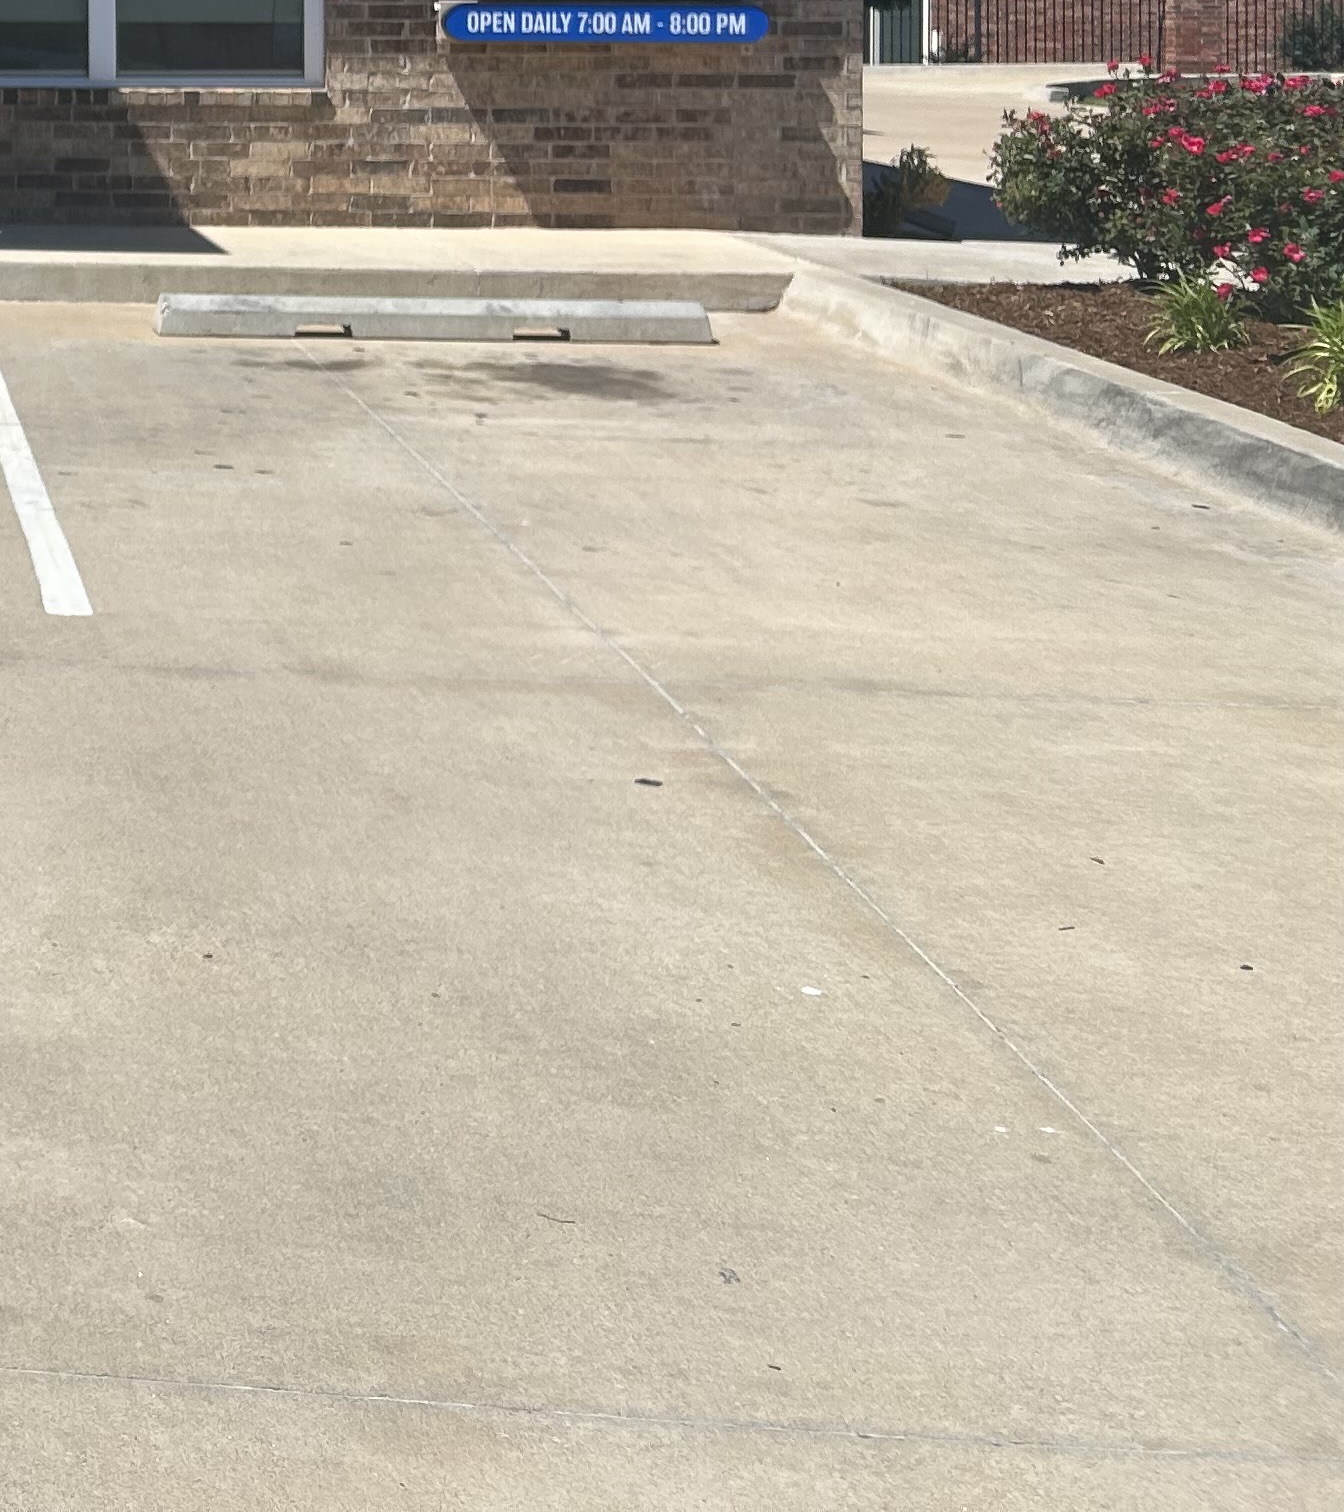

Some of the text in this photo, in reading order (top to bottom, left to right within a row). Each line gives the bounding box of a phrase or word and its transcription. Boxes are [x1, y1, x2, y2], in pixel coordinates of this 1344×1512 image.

[467, 11, 515, 34] OPEN
[521, 11, 572, 34] DAILY
[577, 11, 617, 34] 7:00
[621, 11, 651, 35] AM
[669, 12, 711, 35] 8:00
[716, 12, 746, 35] PM
